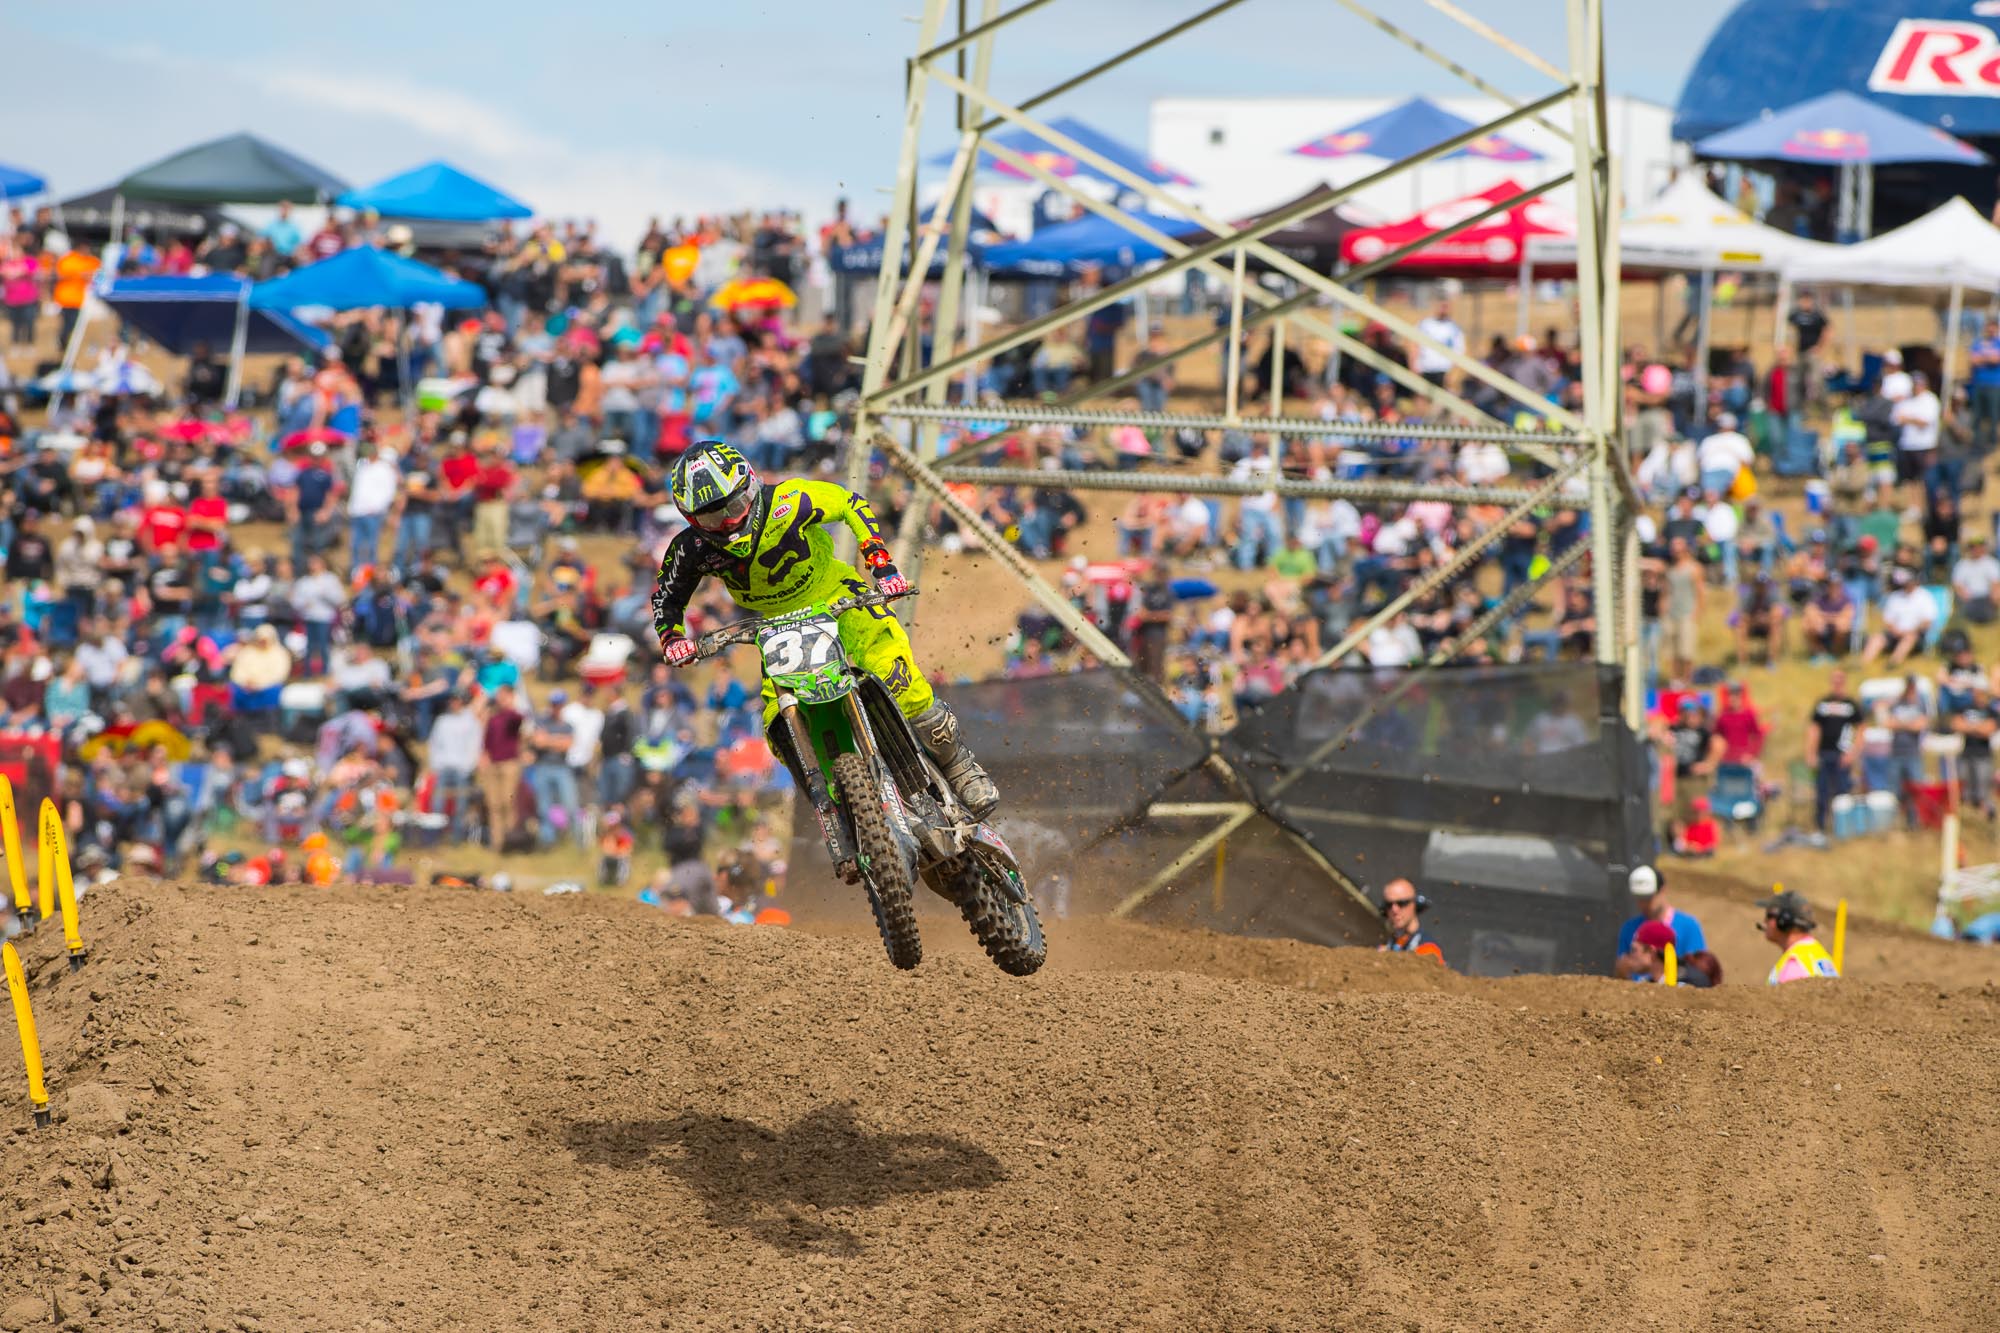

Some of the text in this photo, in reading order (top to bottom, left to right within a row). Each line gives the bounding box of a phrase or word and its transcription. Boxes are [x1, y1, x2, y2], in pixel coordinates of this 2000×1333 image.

[774, 505, 790, 518] BELL
[741, 564, 815, 602] Kawasaki
[777, 621, 800, 633] LUCAS
[763, 621, 839, 677] 37
[883, 781, 911, 835] DUNLOP
